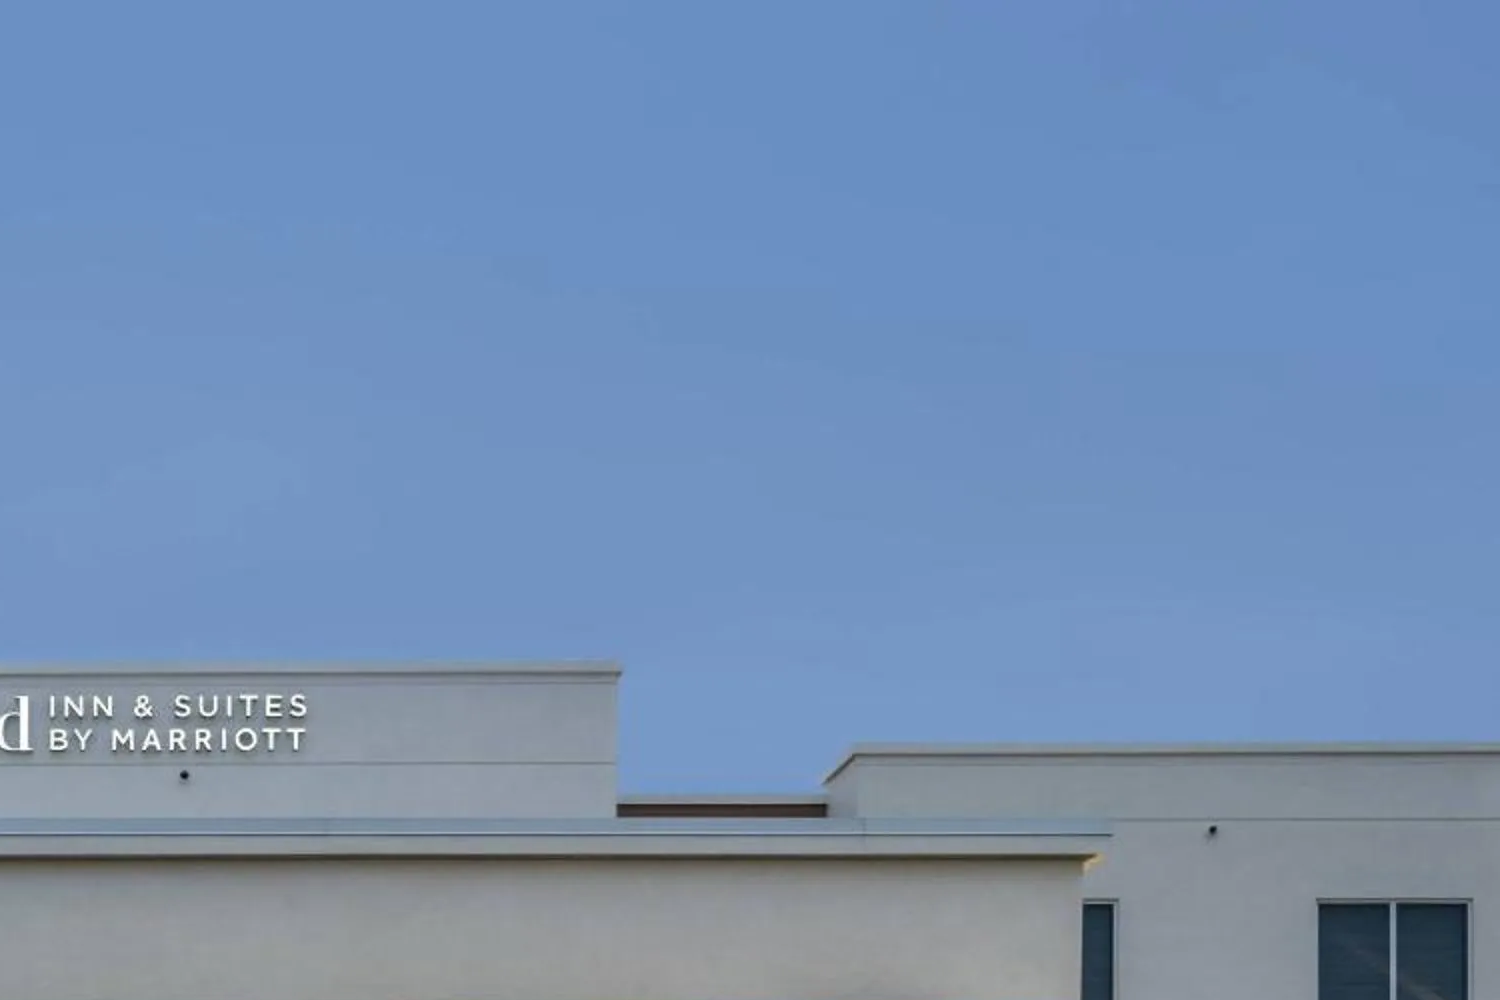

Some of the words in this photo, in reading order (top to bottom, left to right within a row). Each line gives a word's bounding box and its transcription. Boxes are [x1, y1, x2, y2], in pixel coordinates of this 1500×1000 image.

[49, 695, 113, 717] INN
[133, 694, 153, 717] &
[174, 694, 307, 717] SUITES
[49, 728, 93, 751] BY
[111, 727, 306, 751] MARRIOTT
